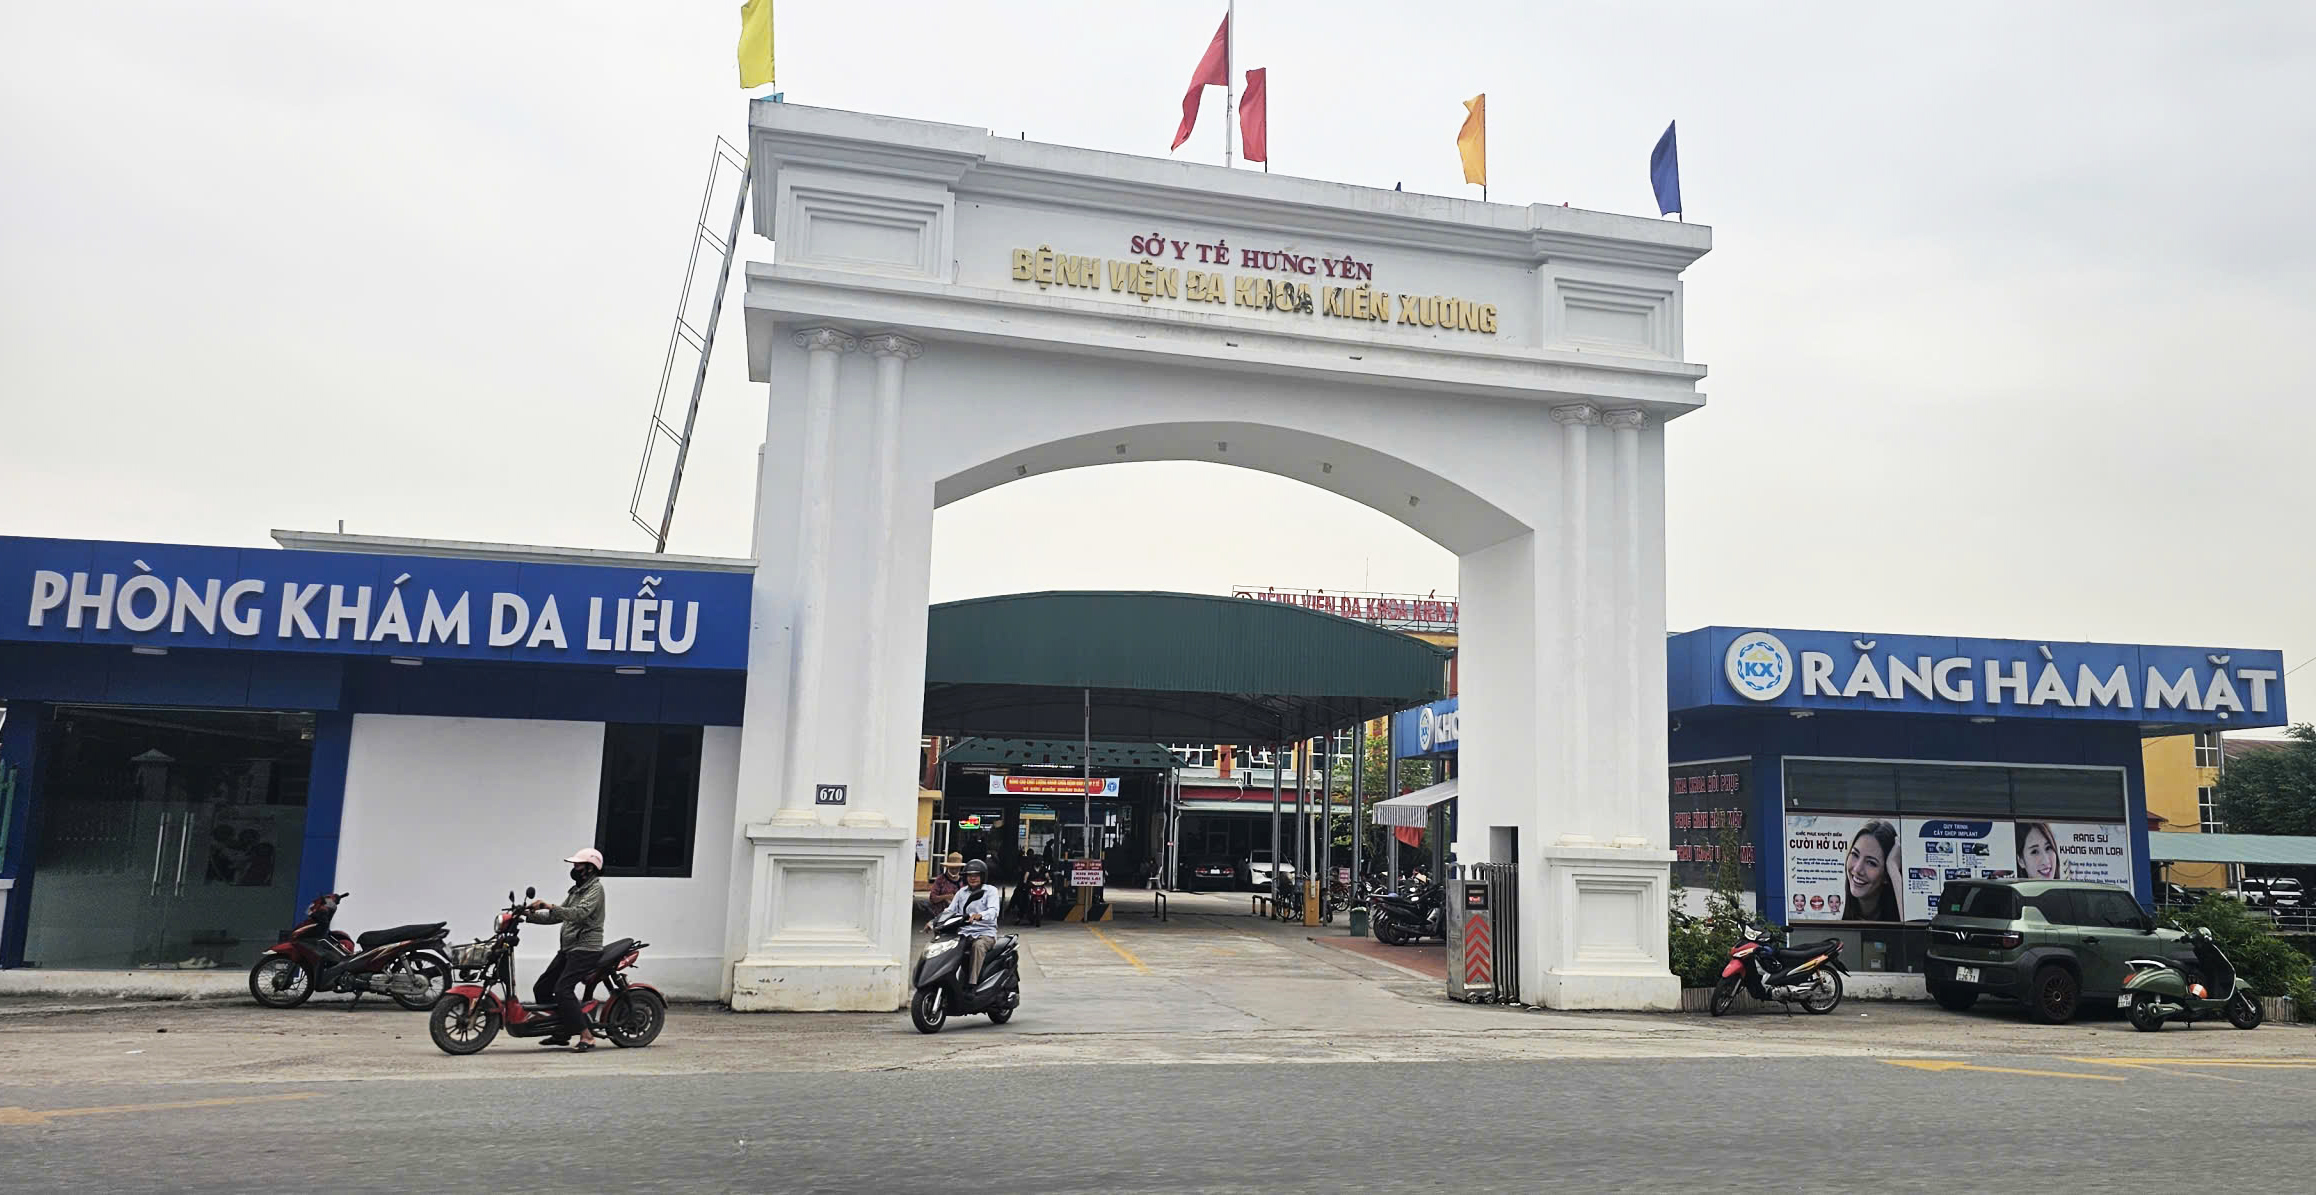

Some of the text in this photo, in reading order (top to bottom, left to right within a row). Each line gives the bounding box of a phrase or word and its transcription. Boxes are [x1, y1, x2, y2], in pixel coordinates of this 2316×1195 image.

[1130, 232, 1374, 281] SỞ Y TẾ HƯNG YÊN
[1012, 244, 1497, 334] BỆNH VIỆN ĐA KHOA KIẾN XƯƠNG
[28, 559, 699, 654] PHÒNG KHÁM DA LIỄU
[1366, 598, 1408, 620] KHOA
[1744, 662, 1775, 678] KX
[1801, 639, 2277, 720] RĂNG HÀM MẶT
[820, 788, 844, 801] 670
[1720, 773, 1739, 795] PHỤC
[1789, 837, 1848, 853] CƯỜI HỞ LỢI
[2088, 846, 2104, 855] KIM
